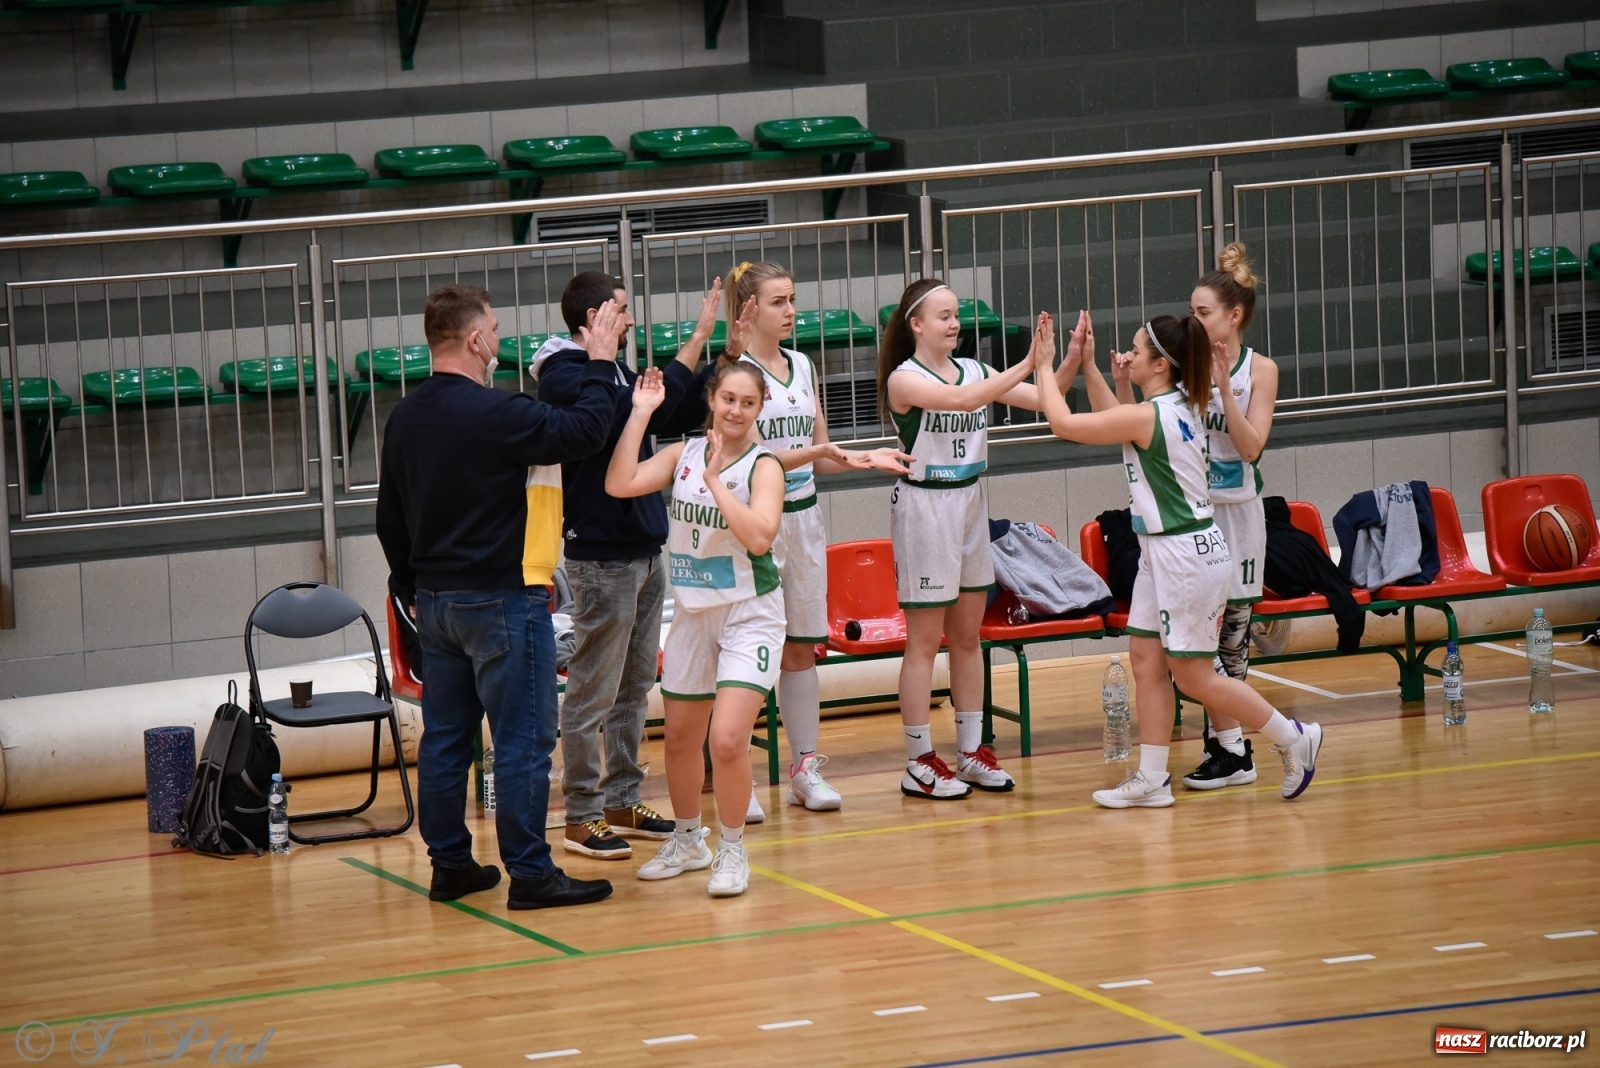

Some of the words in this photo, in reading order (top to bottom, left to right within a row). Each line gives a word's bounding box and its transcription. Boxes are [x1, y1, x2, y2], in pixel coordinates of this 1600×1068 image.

[952, 438, 966, 459] 15
[930, 468, 957, 478] max
[692, 529, 700, 550] 9
[1193, 530, 1227, 555] BAT
[1241, 558, 1255, 585] 11
[757, 645, 770, 672] 9
